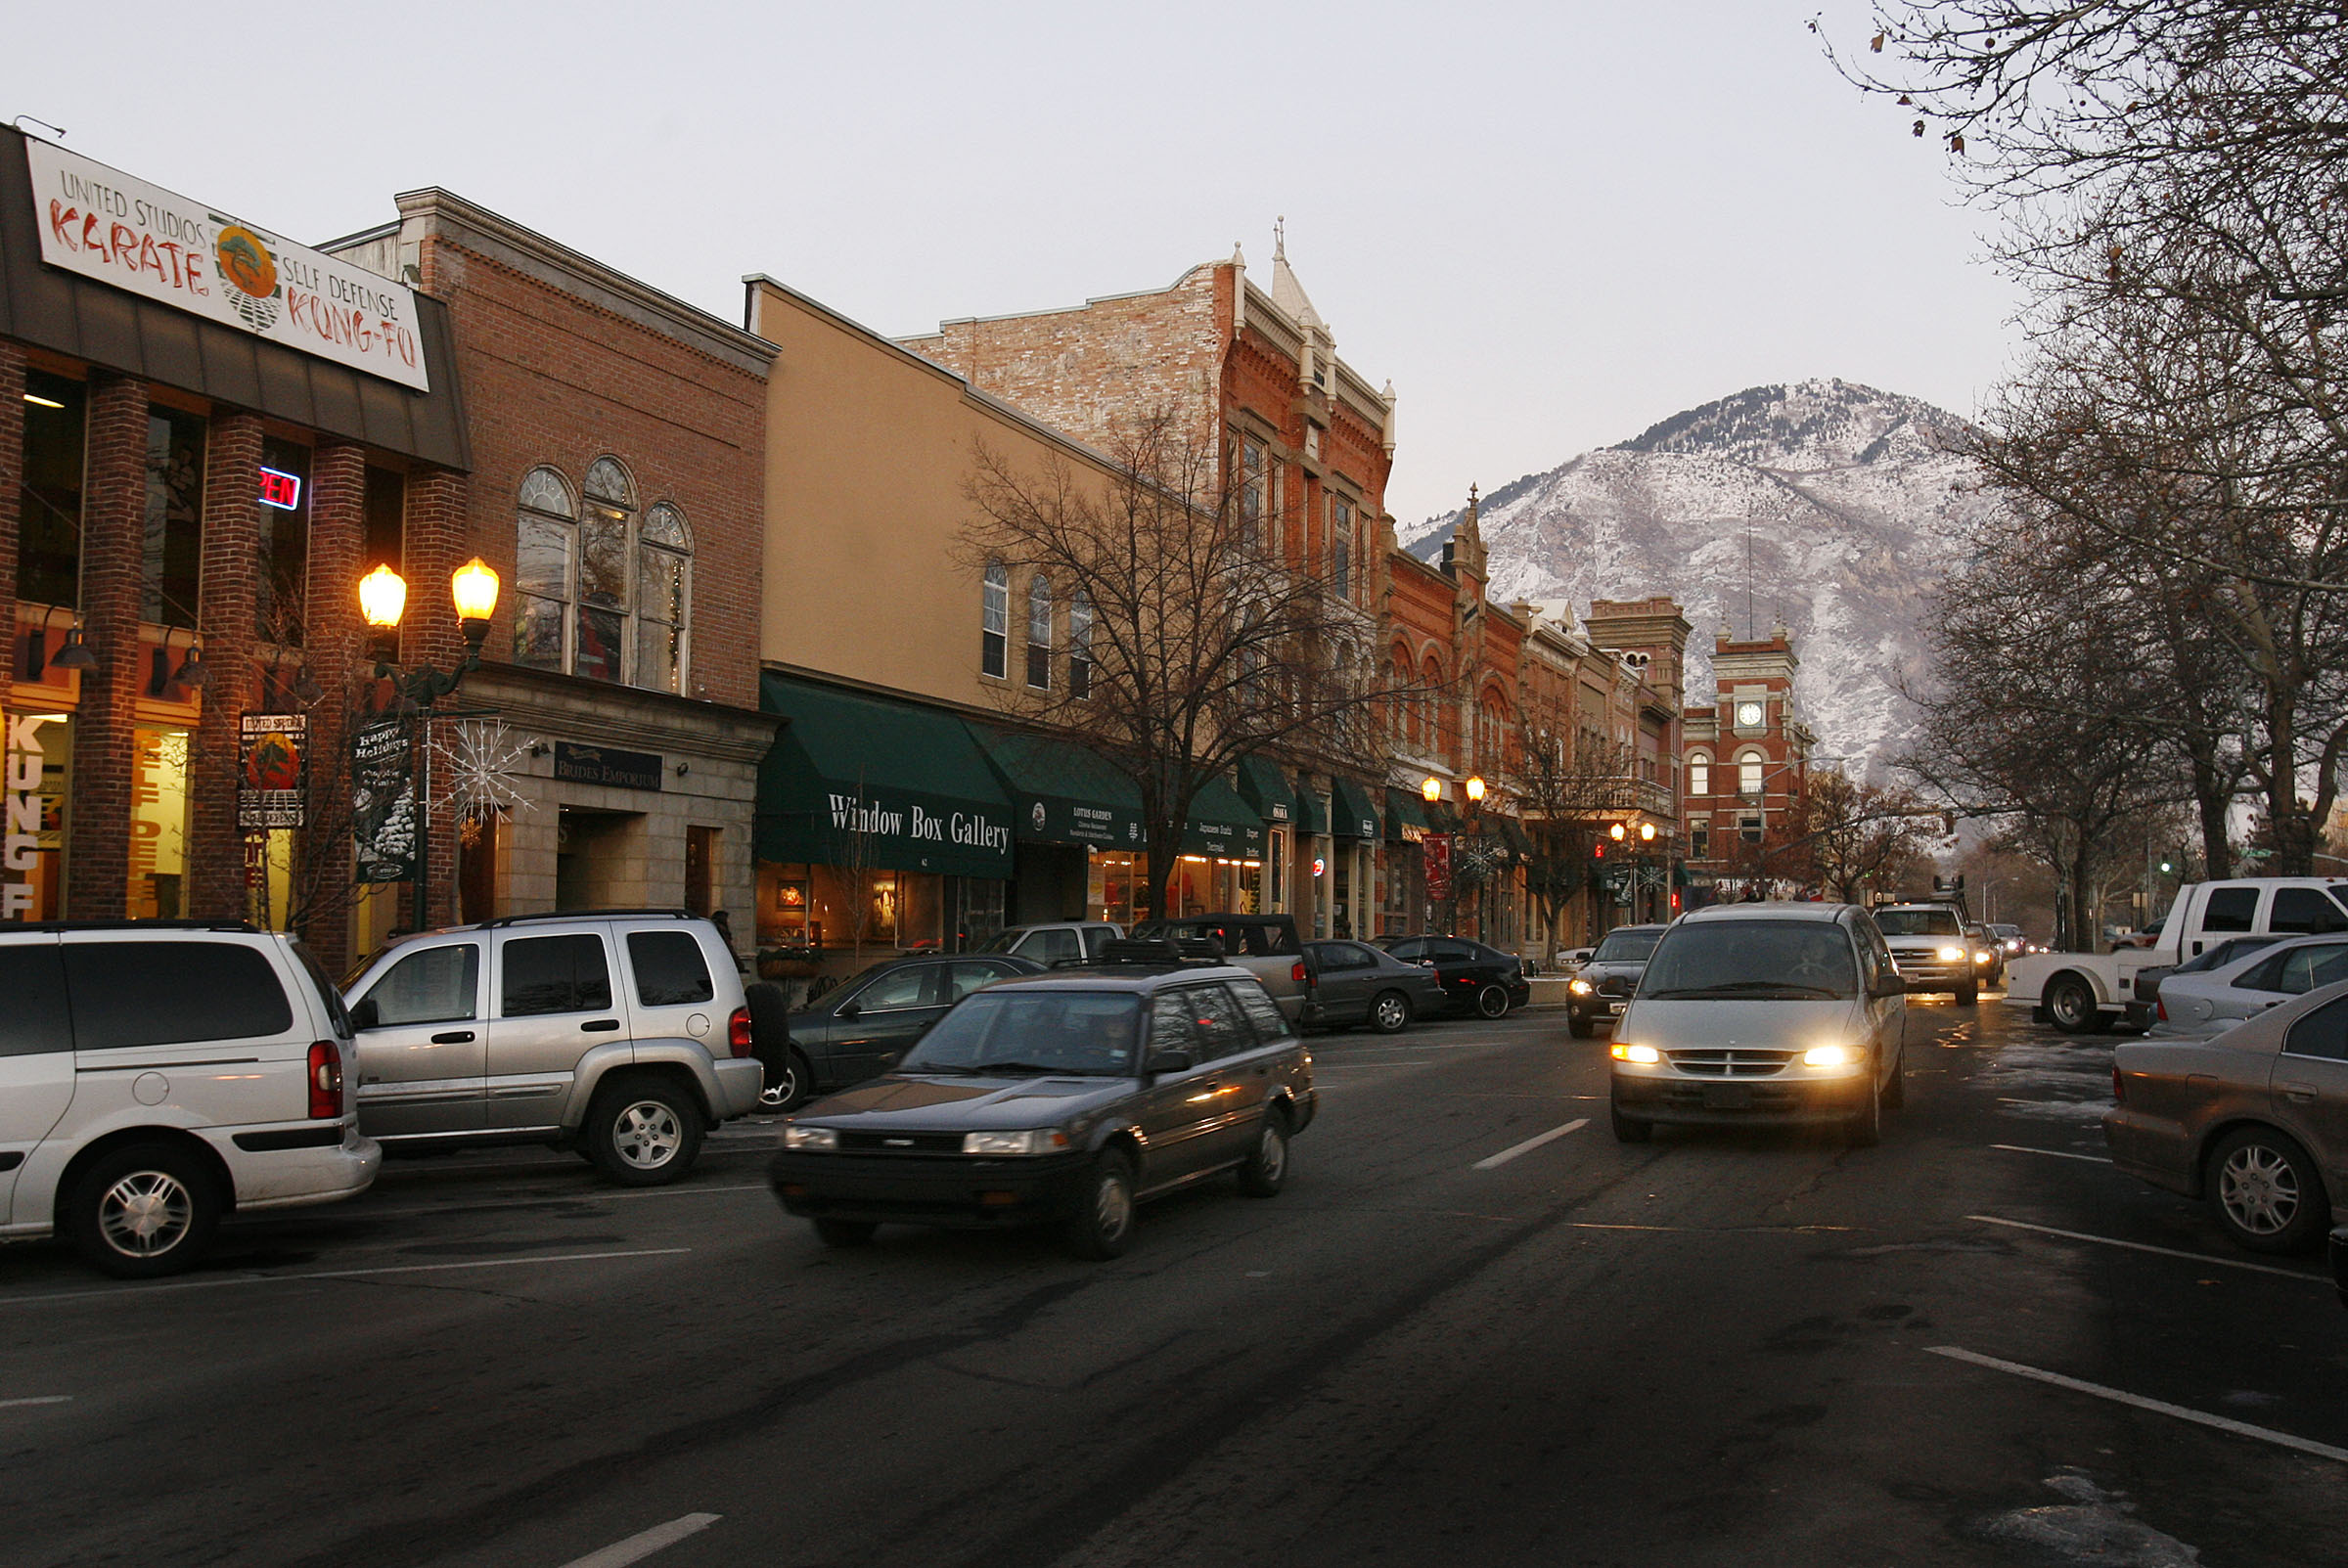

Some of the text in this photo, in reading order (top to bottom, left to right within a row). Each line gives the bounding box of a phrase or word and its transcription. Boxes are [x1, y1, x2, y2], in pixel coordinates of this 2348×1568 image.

[61, 169, 207, 249] UNITED STUDIOS
[50, 198, 209, 297] KARATE
[282, 256, 399, 321] SELF DEFENSE
[287, 287, 417, 369] KUNG-FU
[258, 470, 296, 506] PEN
[355, 738, 409, 759] Holidays
[359, 727, 401, 747] Happy
[558, 760, 659, 788] BRIDES EMPORIUM
[3, 714, 44, 918] KUNG F
[829, 793, 1010, 856] Window Box Gallery
[1073, 807, 1112, 821] LOTUS GARDEN
